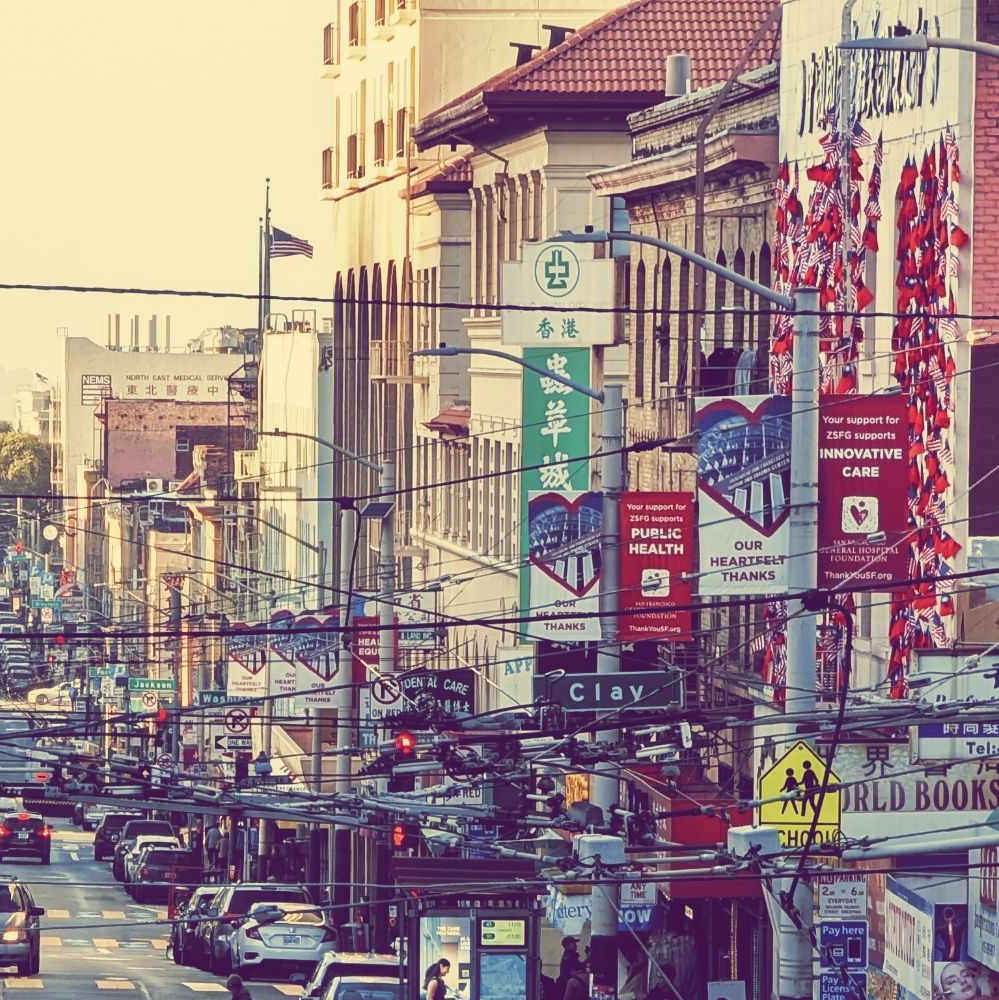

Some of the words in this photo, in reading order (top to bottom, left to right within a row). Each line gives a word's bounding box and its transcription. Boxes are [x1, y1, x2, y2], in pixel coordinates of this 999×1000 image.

[536, 318, 579, 339] 香港
[82, 376, 110, 384] NEMS
[127, 384, 238, 396] 東北醫療中
[822, 415, 844, 424] Your
[846, 416, 883, 426] support
[885, 415, 900, 424] for
[826, 431, 852, 440] ZSFG
[854, 432, 896, 442] supports
[819, 448, 903, 460] INNOVATIVE
[842, 466, 880, 478] CARE
[627, 503, 644, 511] Your
[645, 503, 674, 512] support
[675, 503, 687, 511] for
[651, 515, 683, 523] supports
[631, 528, 682, 539] PUBLIC
[629, 543, 684, 555] HEALTH
[734, 540, 763, 551] OUR
[857, 547, 899, 555] HOSPITAL
[710, 556, 787, 567] HEARTFELT
[830, 555, 888, 563] FOUNDATION
[721, 570, 776, 582] THANKS
[544, 622, 586, 631] THANKS
[406, 632, 421, 640] LAND
[358, 638, 380, 646] HEAL
[133, 681, 172, 689] Jackson
[443, 679, 469, 695] CARE
[569, 682, 644, 703] Clay
[228, 738, 240, 746] ONE
[966, 741, 999, 755] Tel:
[462, 789, 481, 798] RED
[842, 780, 906, 812] RLD
[778, 830, 830, 848] CHOOL
[630, 891, 647, 899] TIME
[822, 926, 840, 936] Pay
[842, 925, 864, 935] here
[822, 976, 839, 985] Pay
